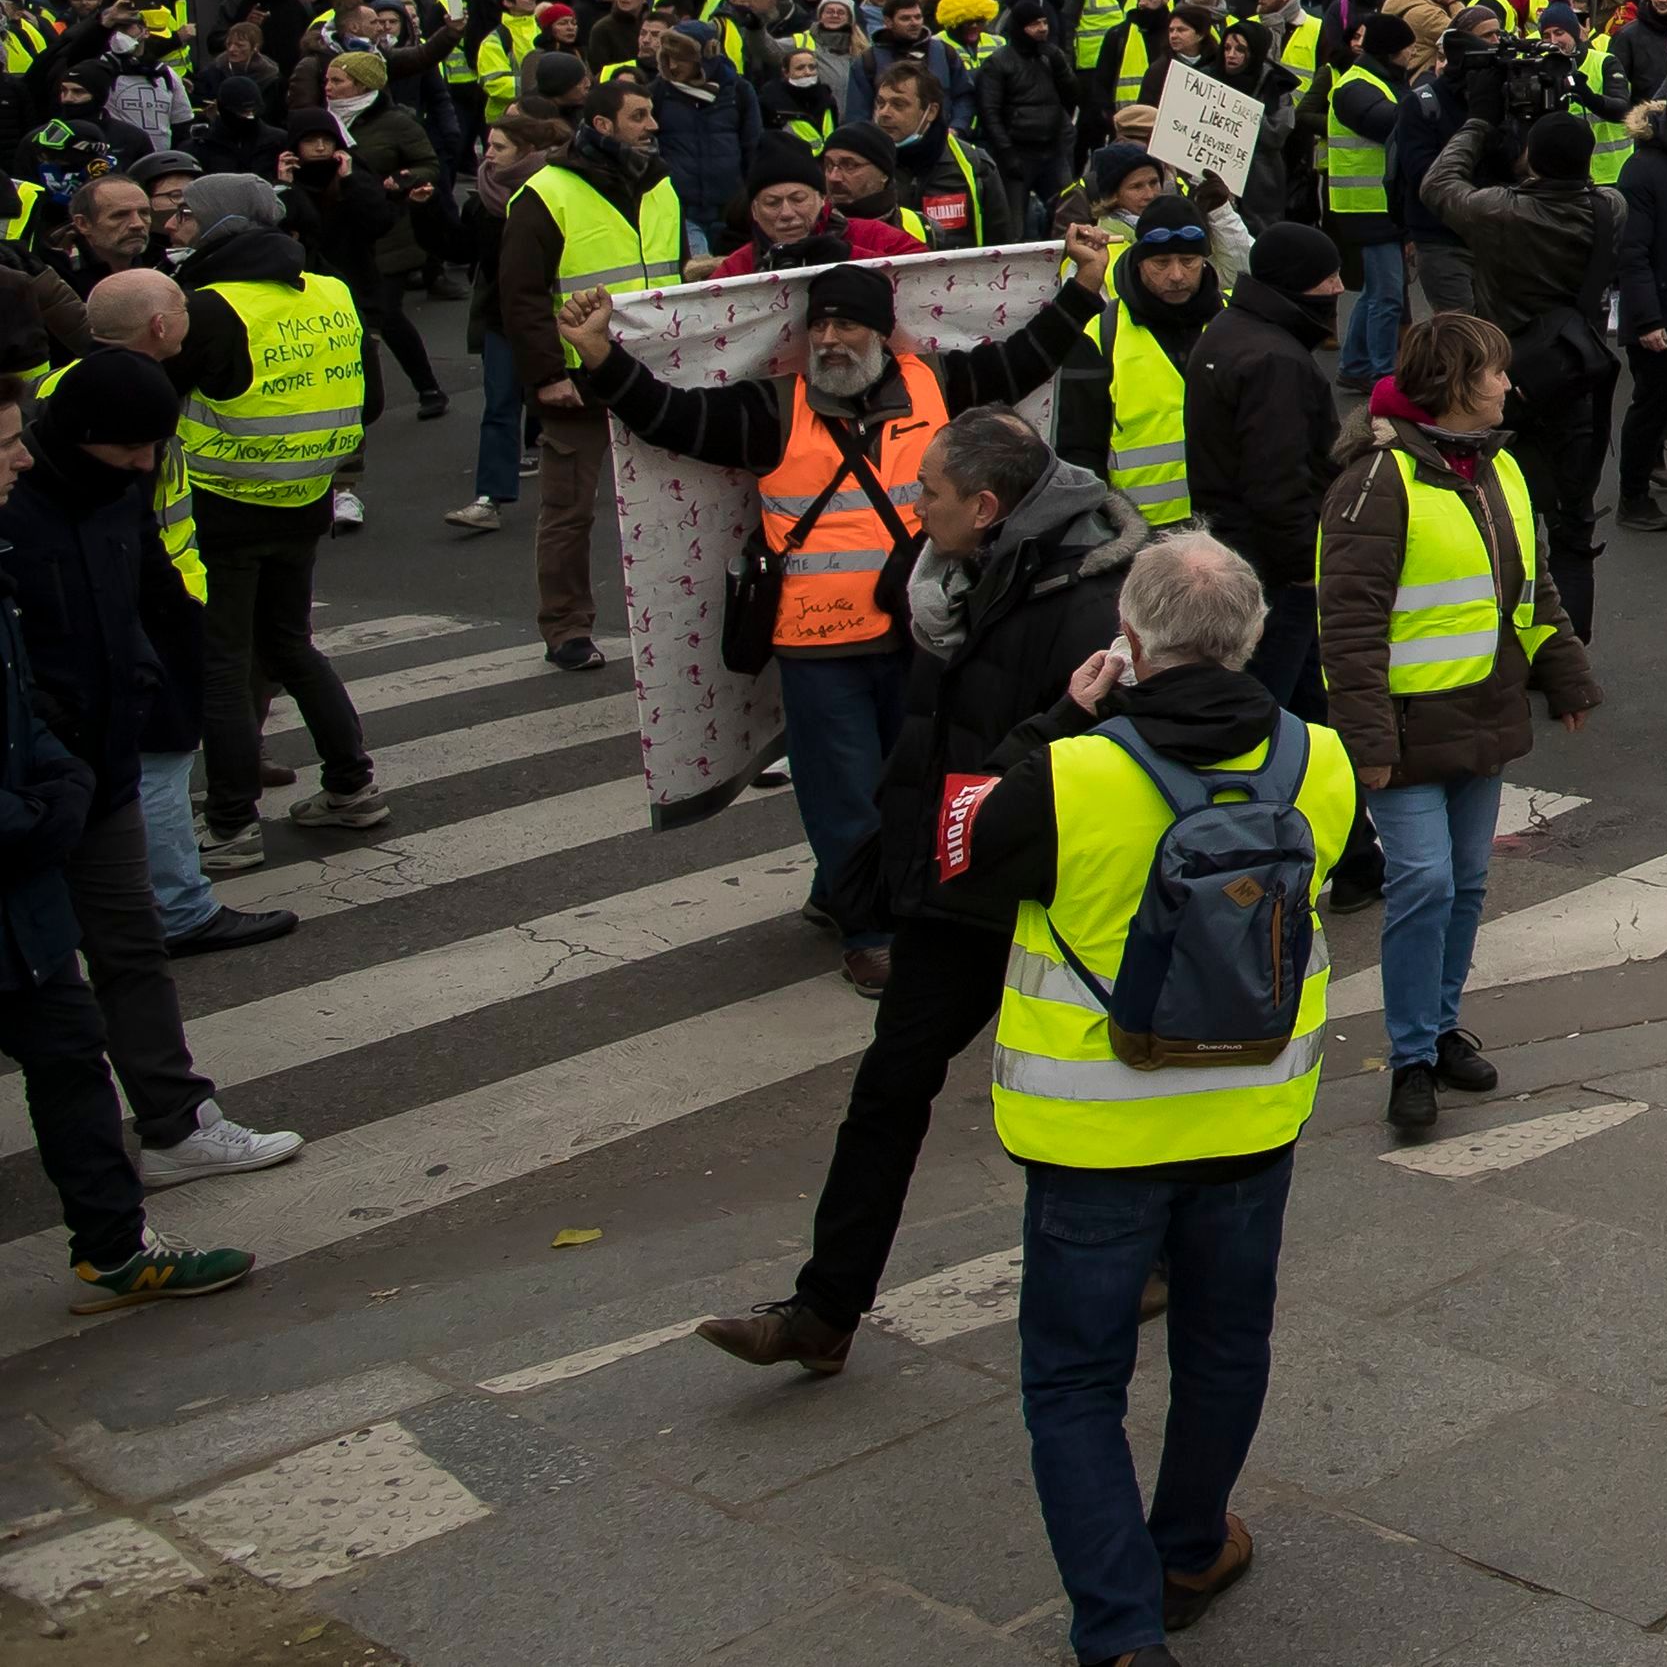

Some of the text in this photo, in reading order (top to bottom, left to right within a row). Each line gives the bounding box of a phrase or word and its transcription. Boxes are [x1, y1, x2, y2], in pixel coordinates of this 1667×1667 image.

[1199, 105, 1243, 138] LIBERTÉ
[1172, 120, 1188, 136] SUR
[1236, 148, 1249, 162] DE
[277, 311, 356, 342] MACRON
[264, 343, 315, 367] REND
[262, 372, 316, 395] NOTRE
[947, 785, 987, 868] ESPOIR
[1197, 1043, 1243, 1051] Quechua
